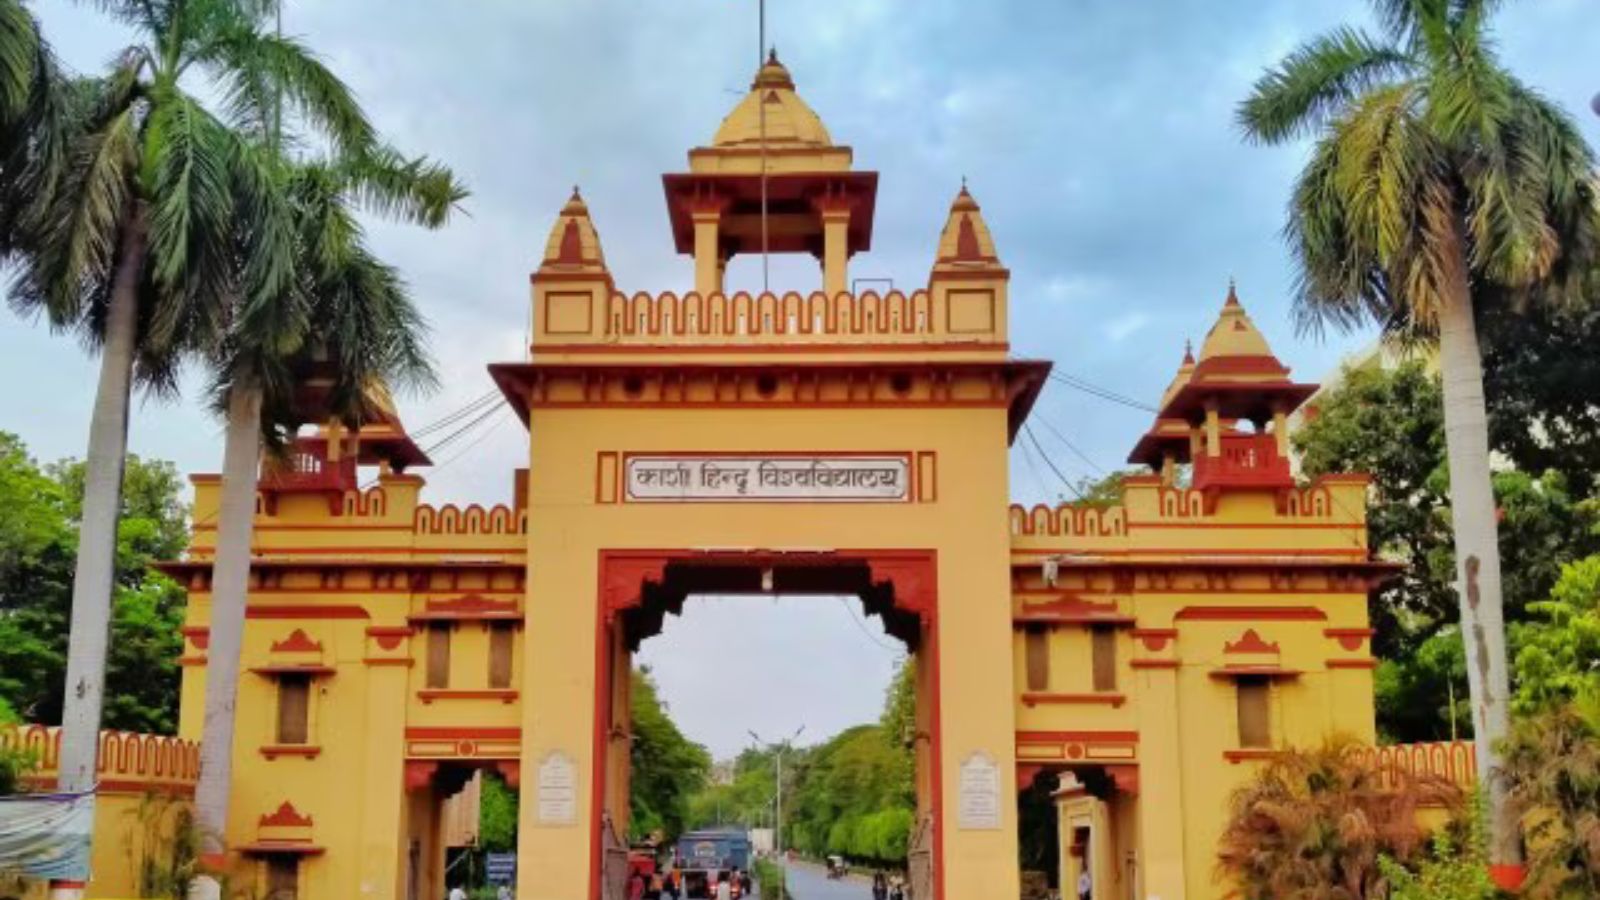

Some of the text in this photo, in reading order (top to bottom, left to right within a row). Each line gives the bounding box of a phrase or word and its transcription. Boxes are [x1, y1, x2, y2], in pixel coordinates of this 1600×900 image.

[634, 460, 898, 494] काशी हिन्दू विश्वविद्यालय
